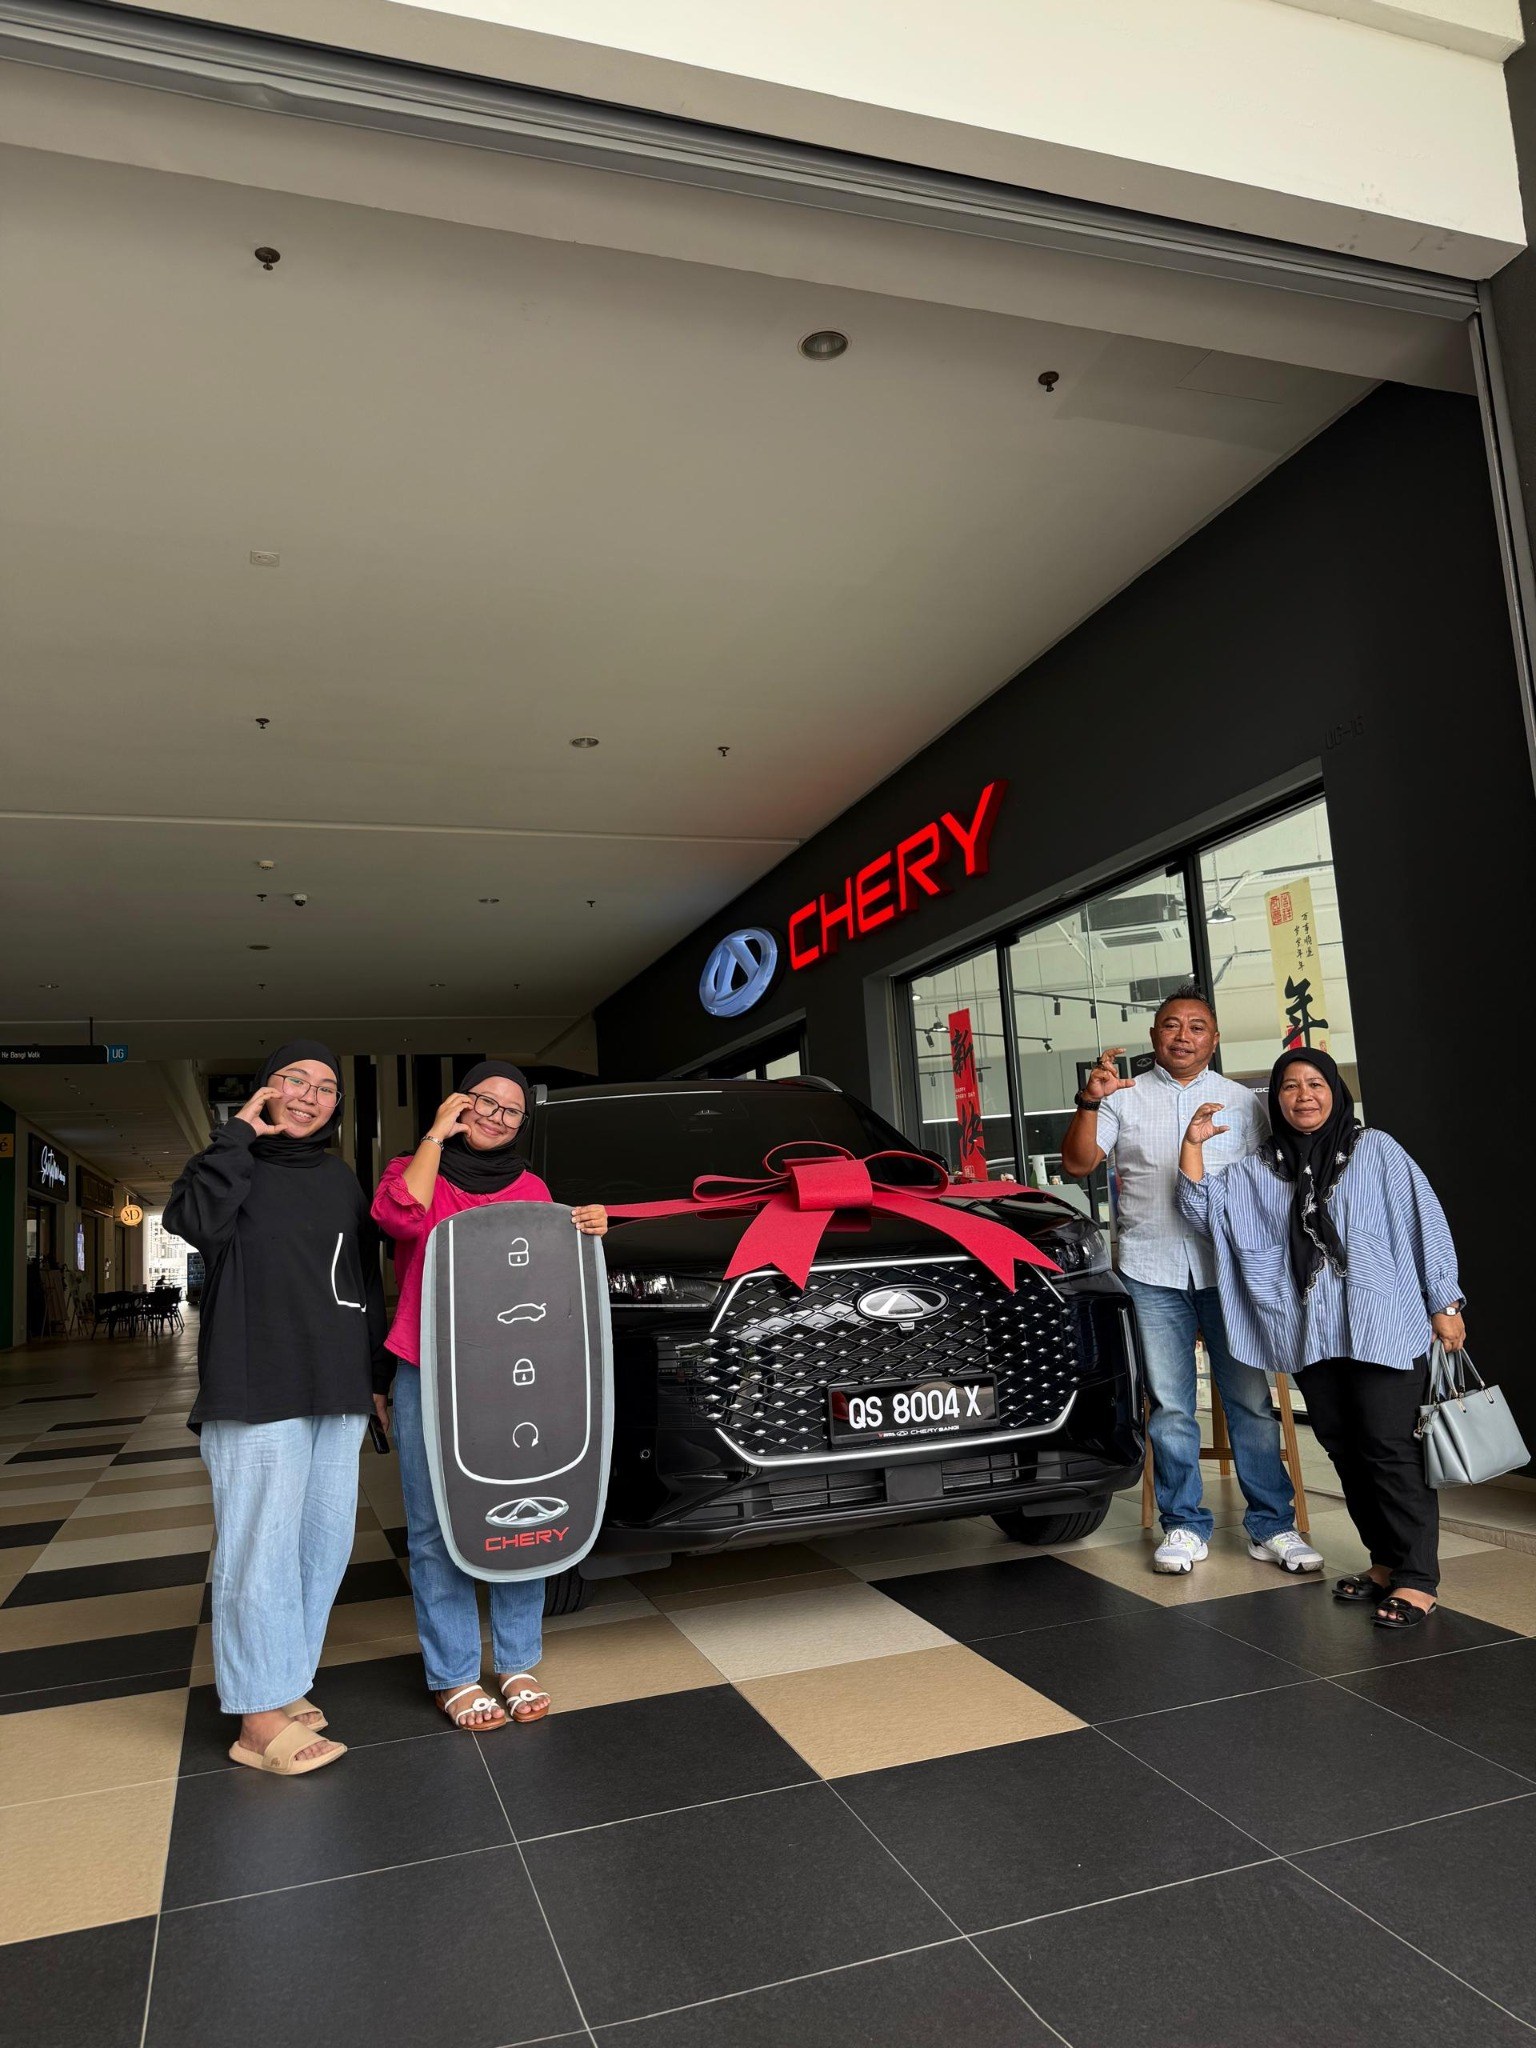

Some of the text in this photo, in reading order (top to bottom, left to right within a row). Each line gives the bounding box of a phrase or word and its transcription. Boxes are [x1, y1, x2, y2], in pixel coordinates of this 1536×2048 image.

[788, 780, 1002, 971] CHERY
[1282, 975, 1329, 1049] 年
[111, 1048, 125, 1059] UG
[848, 1384, 982, 1429] QS 8004 X
[484, 1527, 570, 1552] CHERY
